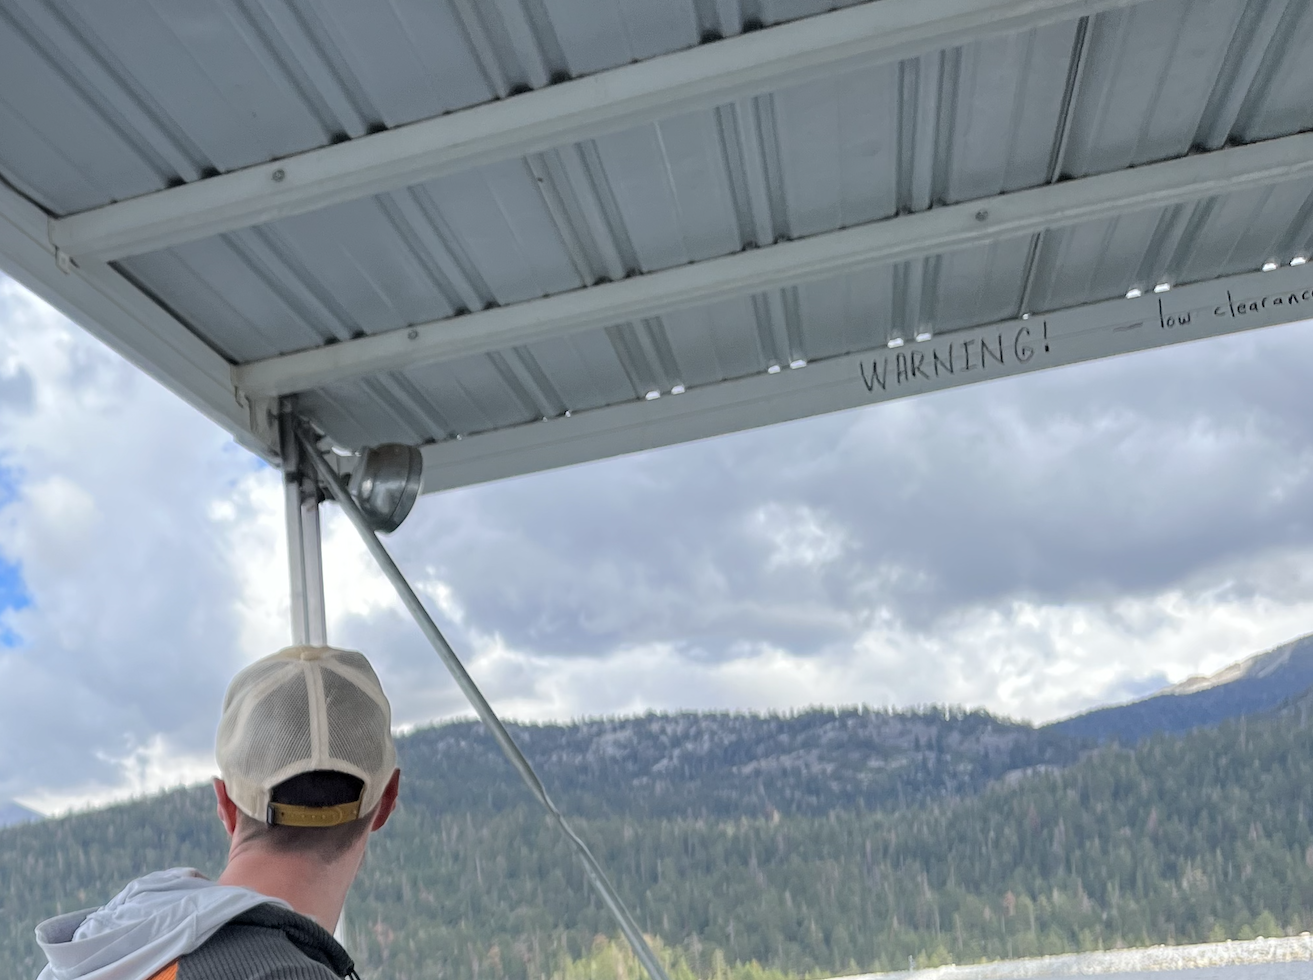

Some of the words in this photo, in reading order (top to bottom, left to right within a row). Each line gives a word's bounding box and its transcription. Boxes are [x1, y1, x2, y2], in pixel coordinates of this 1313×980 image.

[859, 320, 1050, 392] WARNING!
[1158, 297, 1191, 329] low
[1214, 289, 1313, 317] clearanc
